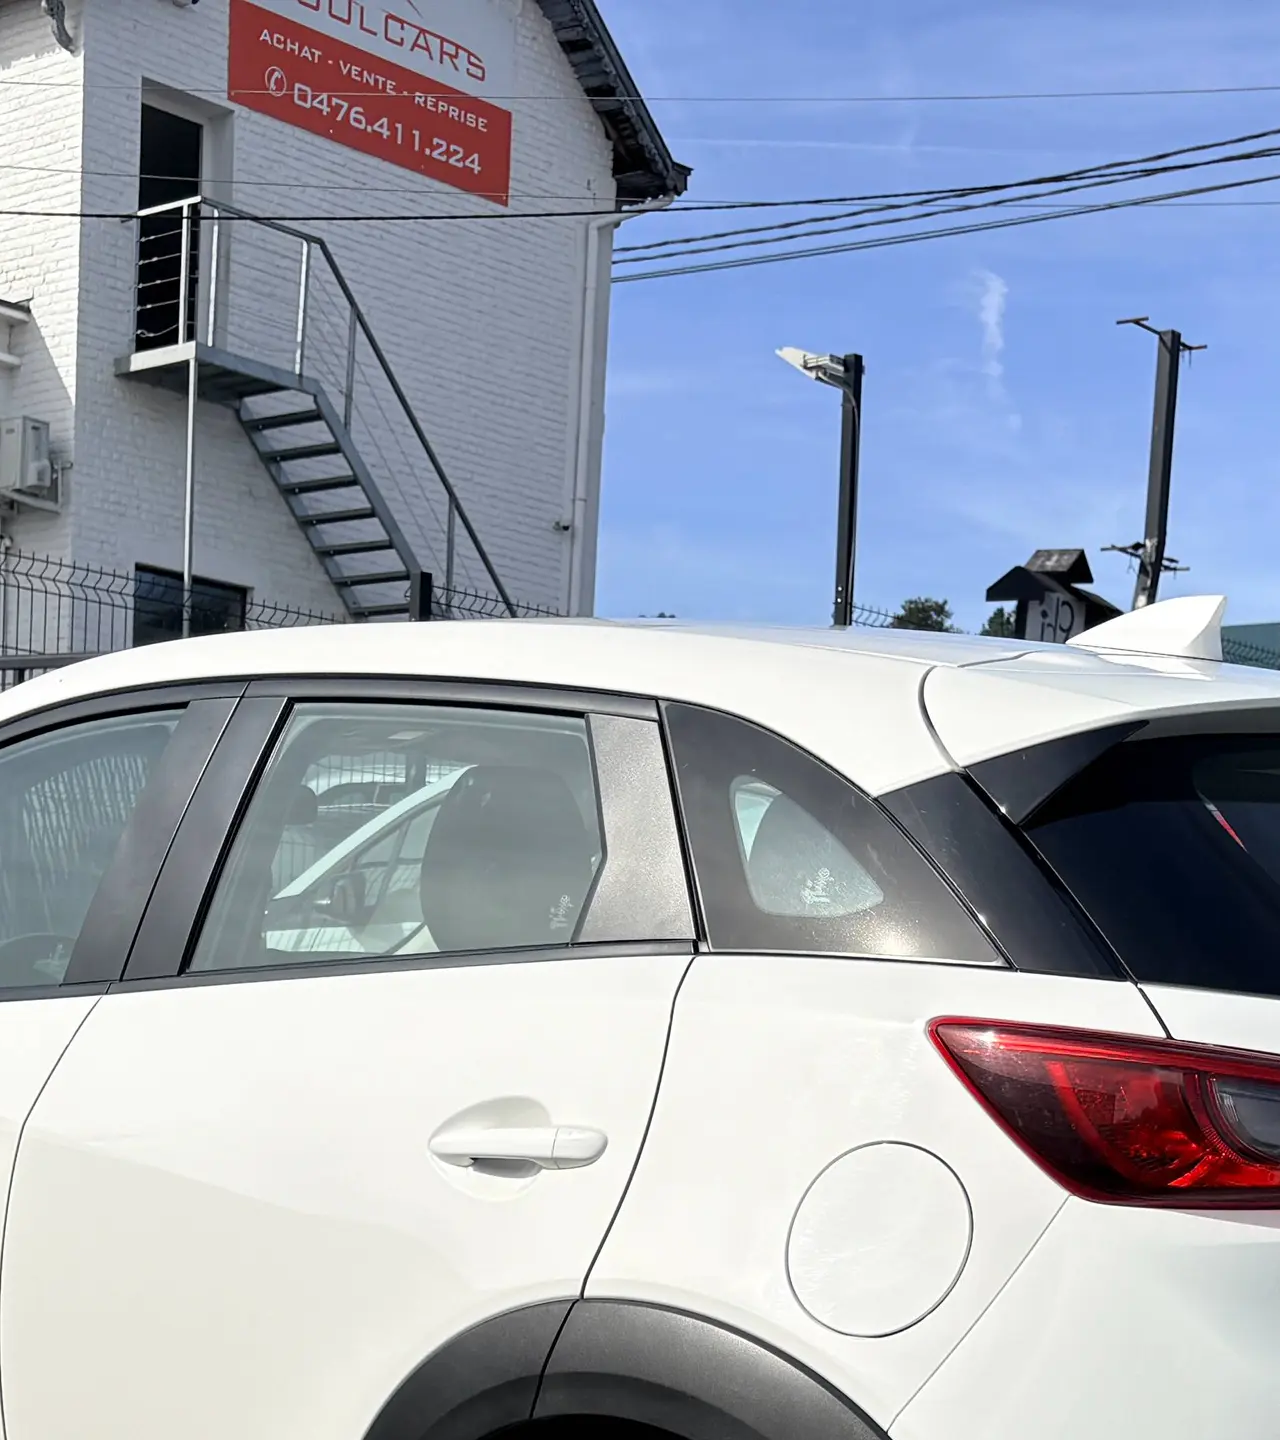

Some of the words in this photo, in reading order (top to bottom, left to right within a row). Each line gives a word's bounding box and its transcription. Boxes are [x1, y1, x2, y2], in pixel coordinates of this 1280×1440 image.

[259, 29, 322, 65] ACHAT
[338, 60, 396, 96] VENTE
[413, 91, 488, 132] REPRISE
[293, 82, 482, 175] 0476.411.224
